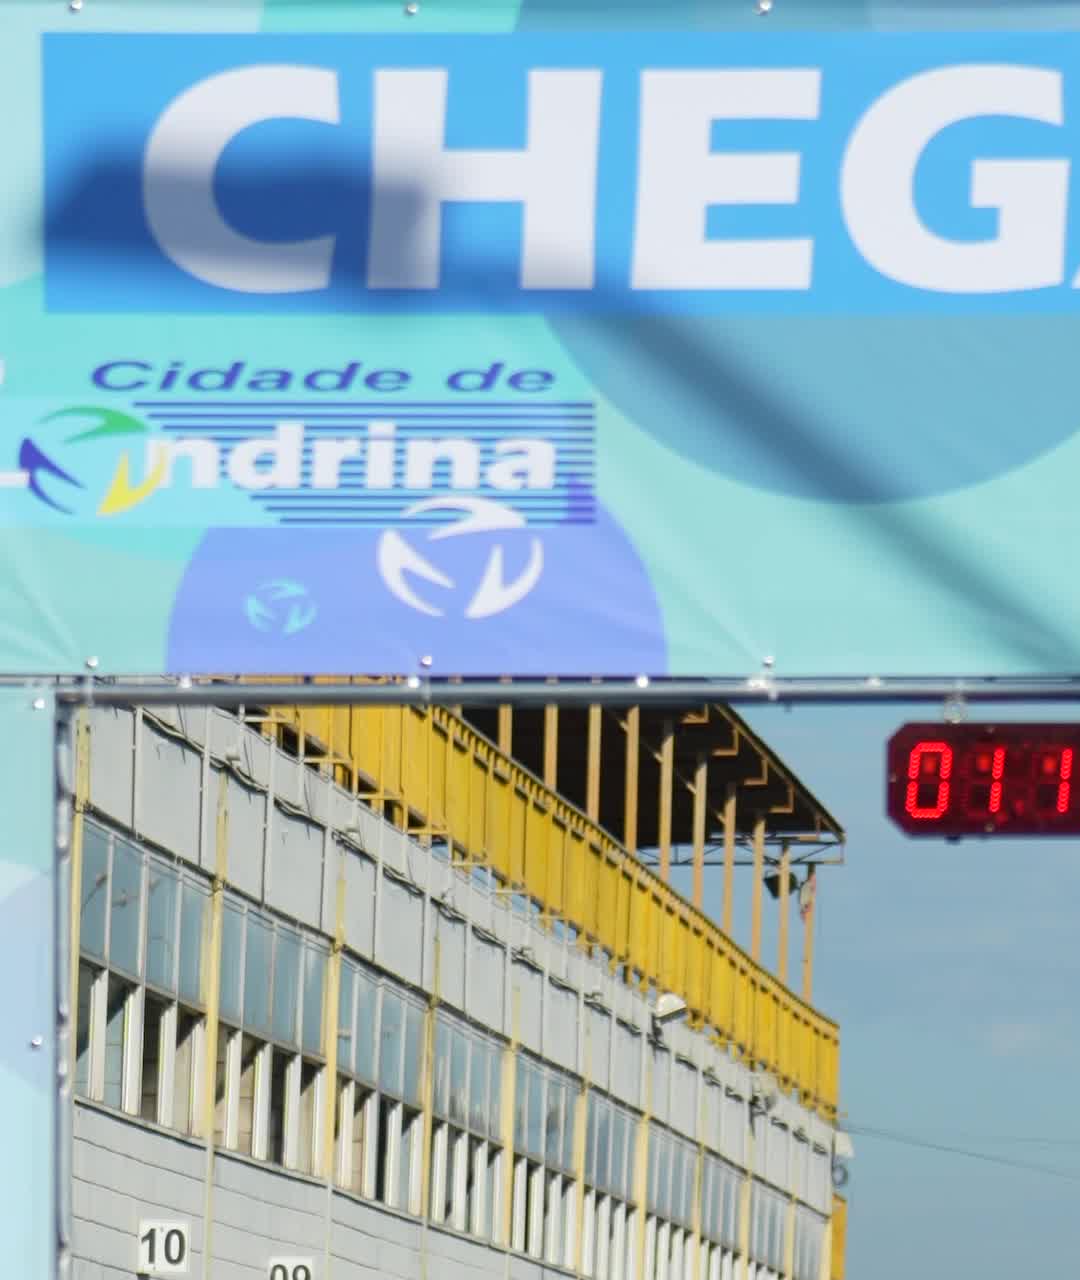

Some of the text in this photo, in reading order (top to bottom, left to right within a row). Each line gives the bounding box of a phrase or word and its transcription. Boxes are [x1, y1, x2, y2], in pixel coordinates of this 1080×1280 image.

[91, 361, 556, 392] Cidade de
[140, 1228, 186, 1265] 10
